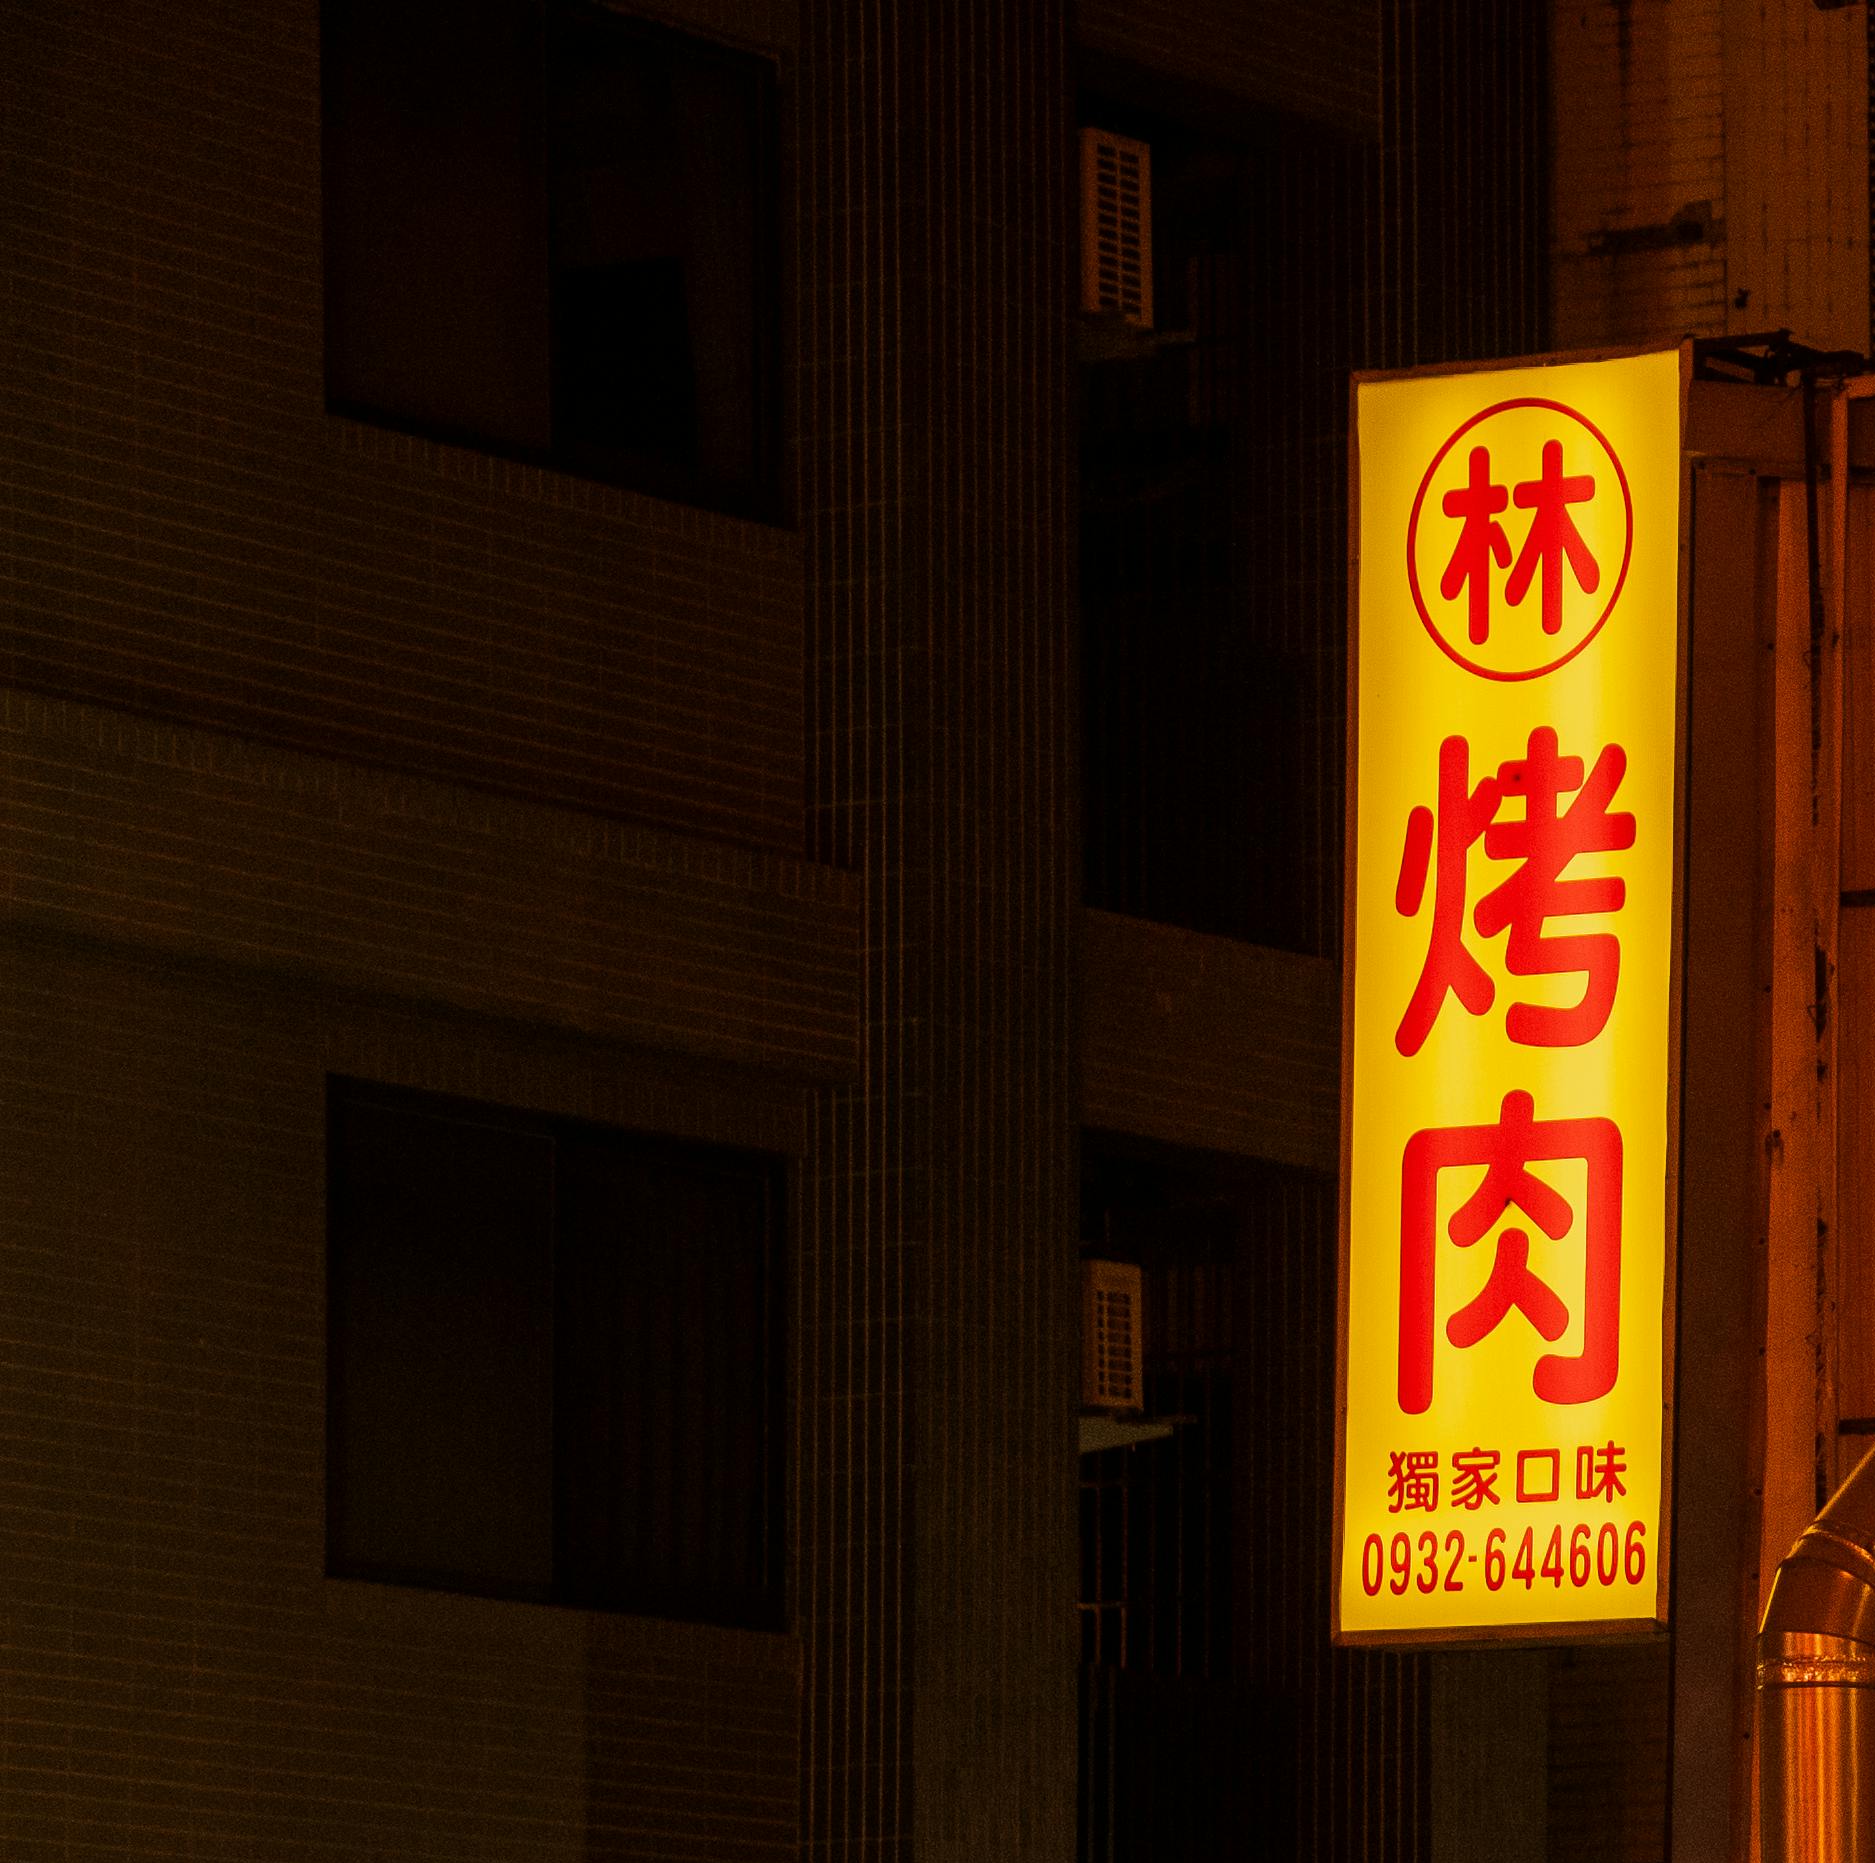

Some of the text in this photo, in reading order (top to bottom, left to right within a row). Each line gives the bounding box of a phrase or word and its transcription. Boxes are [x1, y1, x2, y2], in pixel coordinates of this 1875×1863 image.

[1440, 437, 1603, 646] 林
[1394, 724, 1639, 1416] 烤肉
[1386, 1439, 1629, 1515] 獨家口味
[1361, 1519, 1648, 1598] 0932-644606
